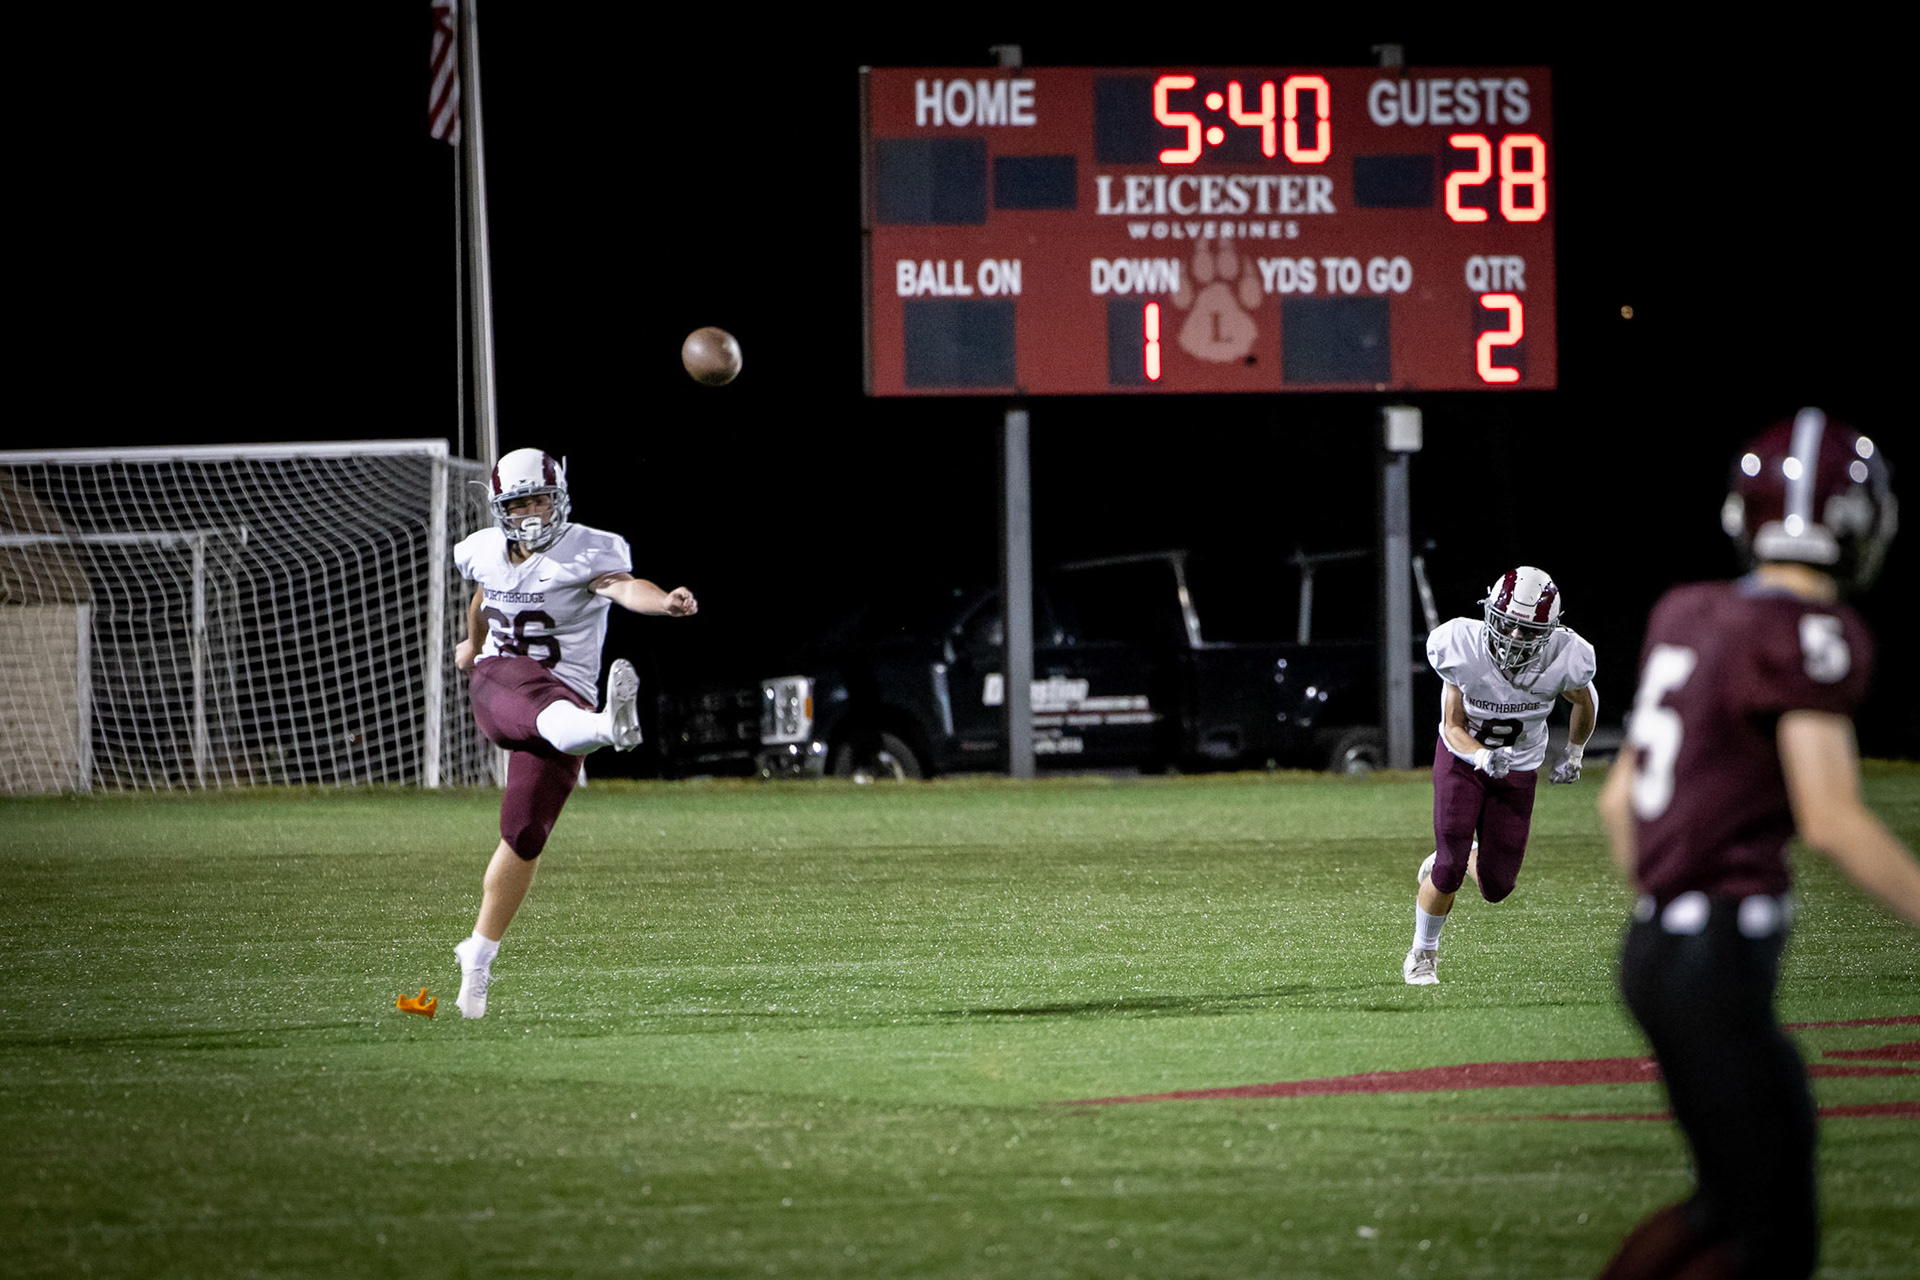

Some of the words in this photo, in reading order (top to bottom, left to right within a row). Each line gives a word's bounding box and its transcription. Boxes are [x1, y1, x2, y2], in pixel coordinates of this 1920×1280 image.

[915, 78, 1036, 127] HOME
[1152, 75, 1332, 165] 5:40
[1367, 77, 1531, 127] GUESTS
[1095, 174, 1337, 216] LEICESTER
[1444, 133, 1548, 224] 28
[1127, 220, 1300, 240] WOLVERINES
[896, 258, 973, 297] BALL
[977, 257, 1023, 296] ON
[1090, 257, 1181, 295] DOWN
[1257, 256, 1317, 294] YDS
[1321, 256, 1362, 294] TO
[1366, 255, 1413, 294] GO
[1464, 255, 1527, 292] QTR
[1142, 300, 1163, 382] 1
[1209, 311, 1233, 345] L
[1474, 292, 1526, 384] 2
[1797, 613, 1852, 685] 5
[1468, 697, 1541, 714] NORTHBRIDGE
[1630, 642, 1698, 823] 5
